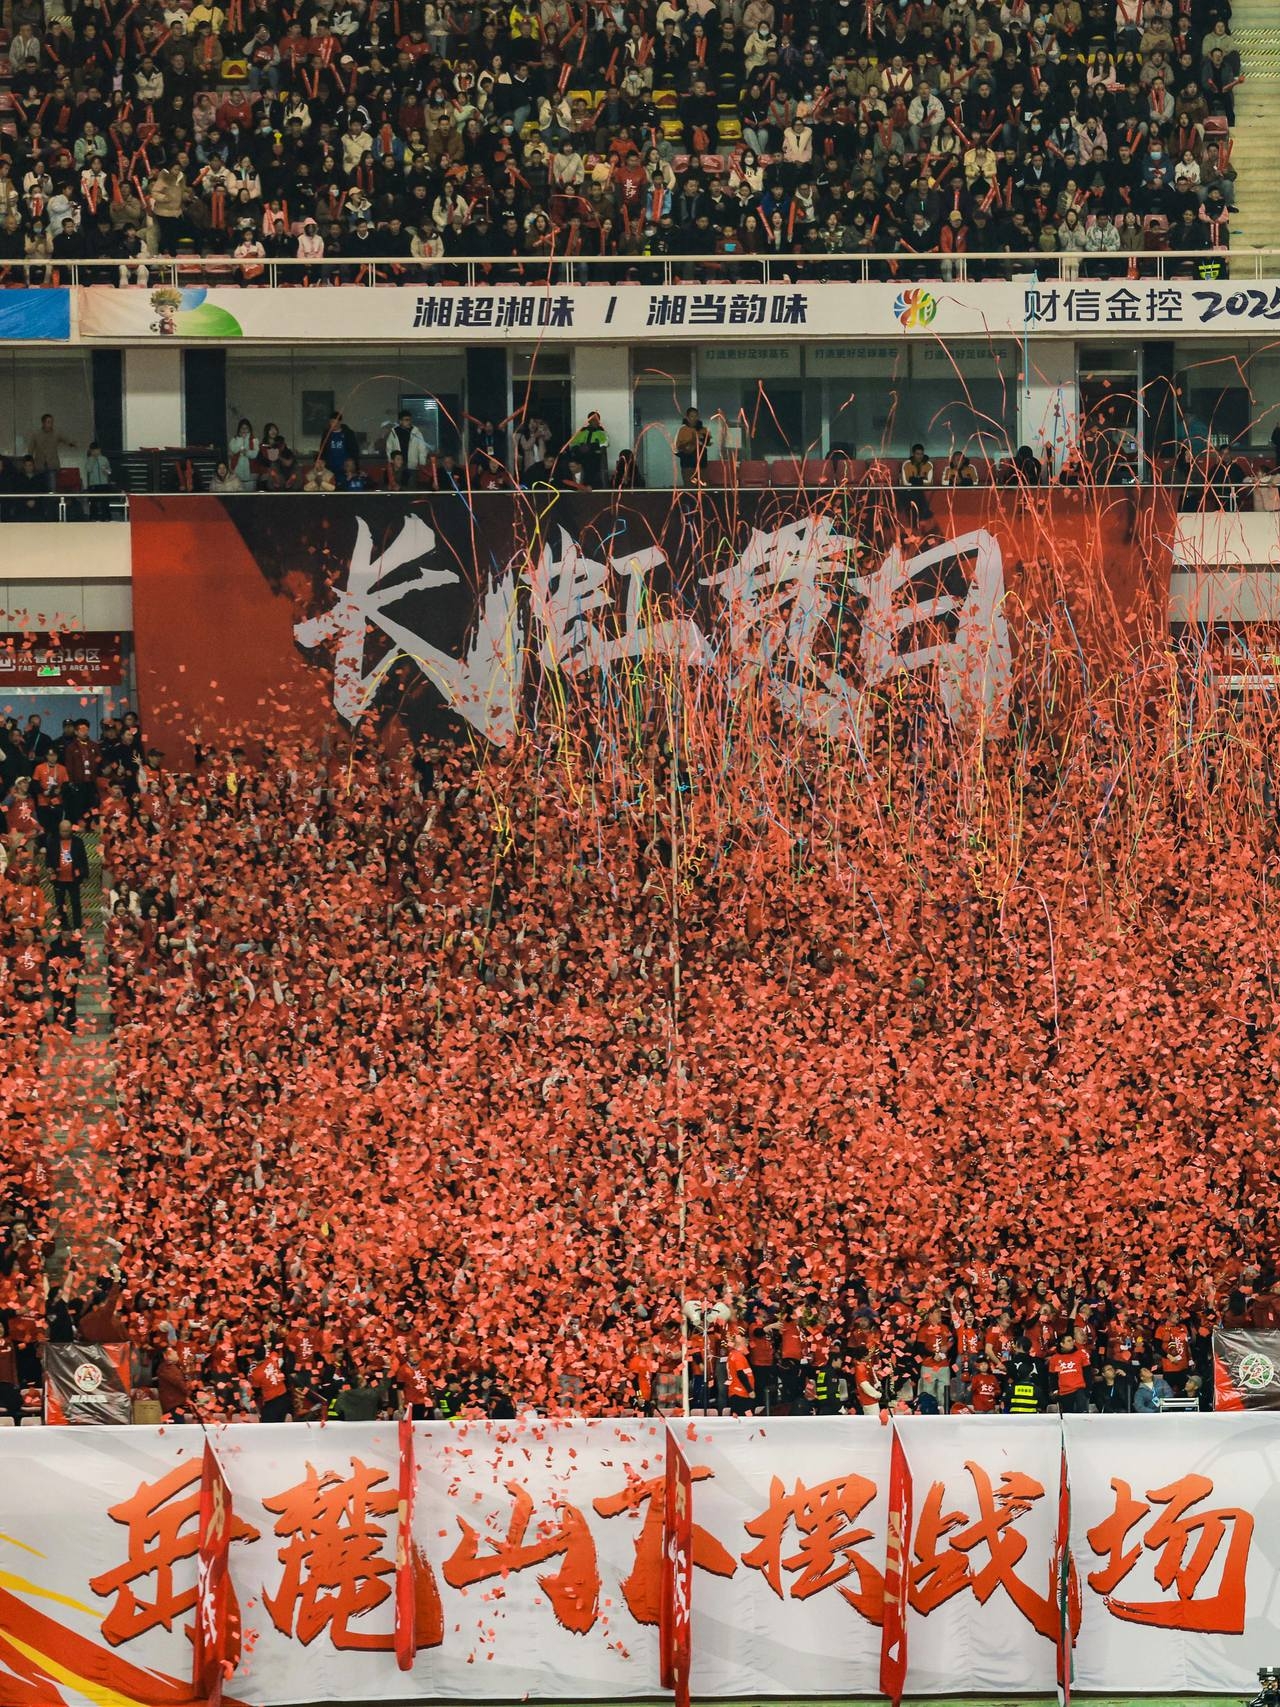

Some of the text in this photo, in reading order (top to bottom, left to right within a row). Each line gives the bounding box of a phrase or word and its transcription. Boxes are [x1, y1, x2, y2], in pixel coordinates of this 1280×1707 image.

[413, 296, 576, 328] 湘超湘味
[646, 294, 808, 326] 湘当韵味
[1024, 288, 1184, 323] 财信金控
[89, 1456, 1255, 1652] 岳麓山下摆战场
